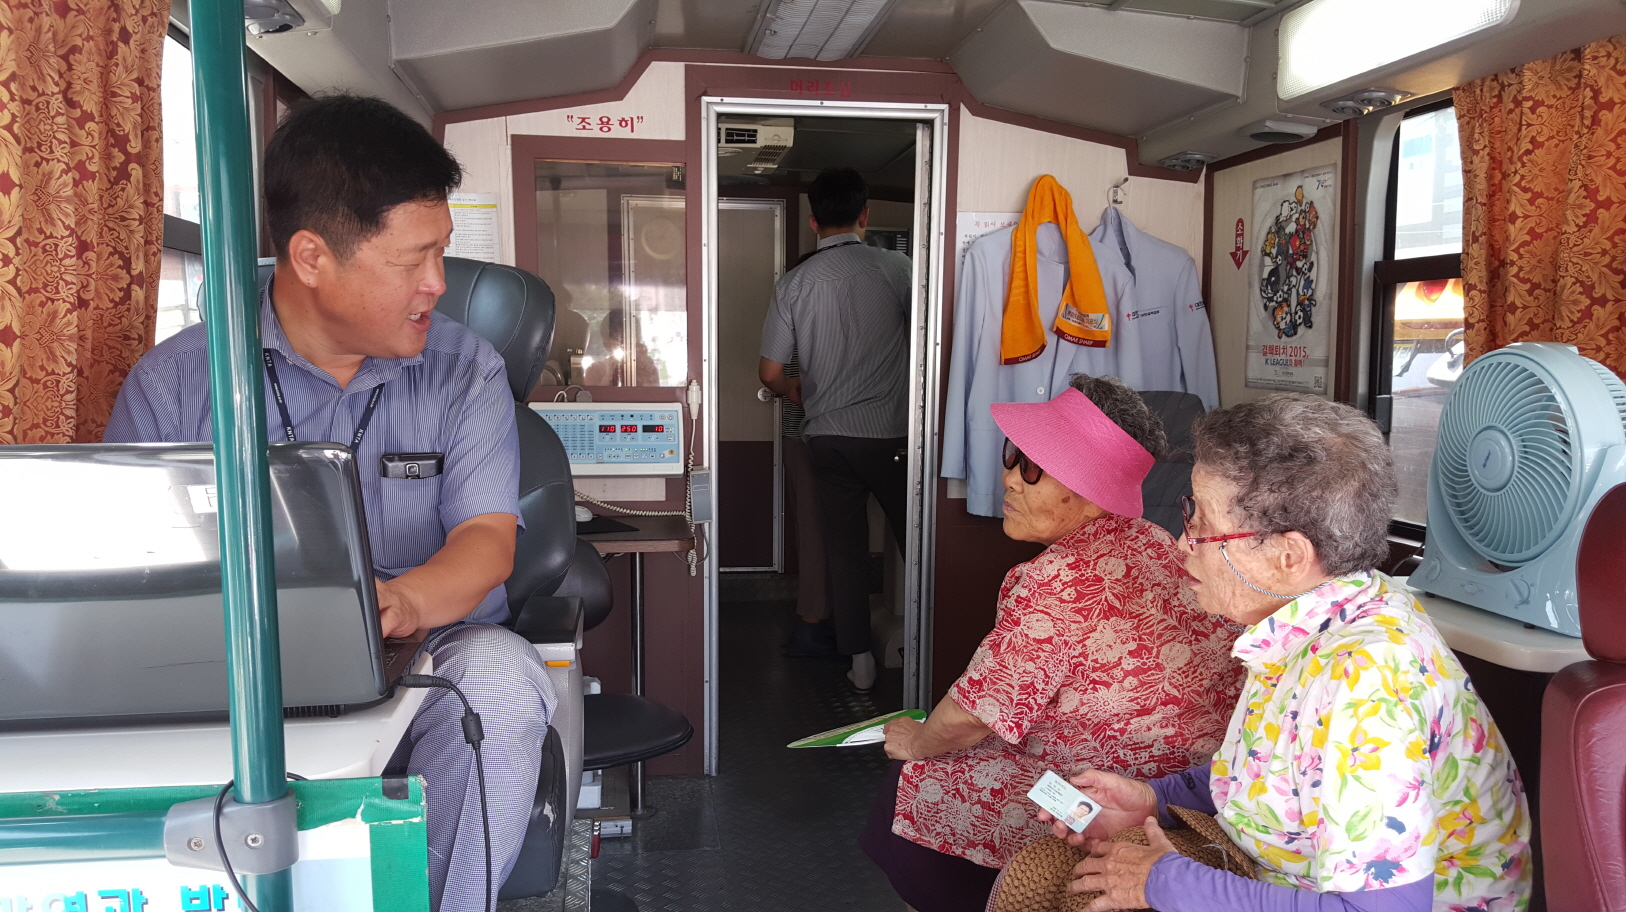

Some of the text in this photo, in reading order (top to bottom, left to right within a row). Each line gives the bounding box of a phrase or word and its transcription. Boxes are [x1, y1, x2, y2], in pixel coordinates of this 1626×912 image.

[790, 80, 851, 98] 머리조심
[1236, 222, 1244, 263] 소화기
[1262, 344, 1309, 359] 결핵퇴치 2015,
[601, 425, 663, 433] 110 250 10
